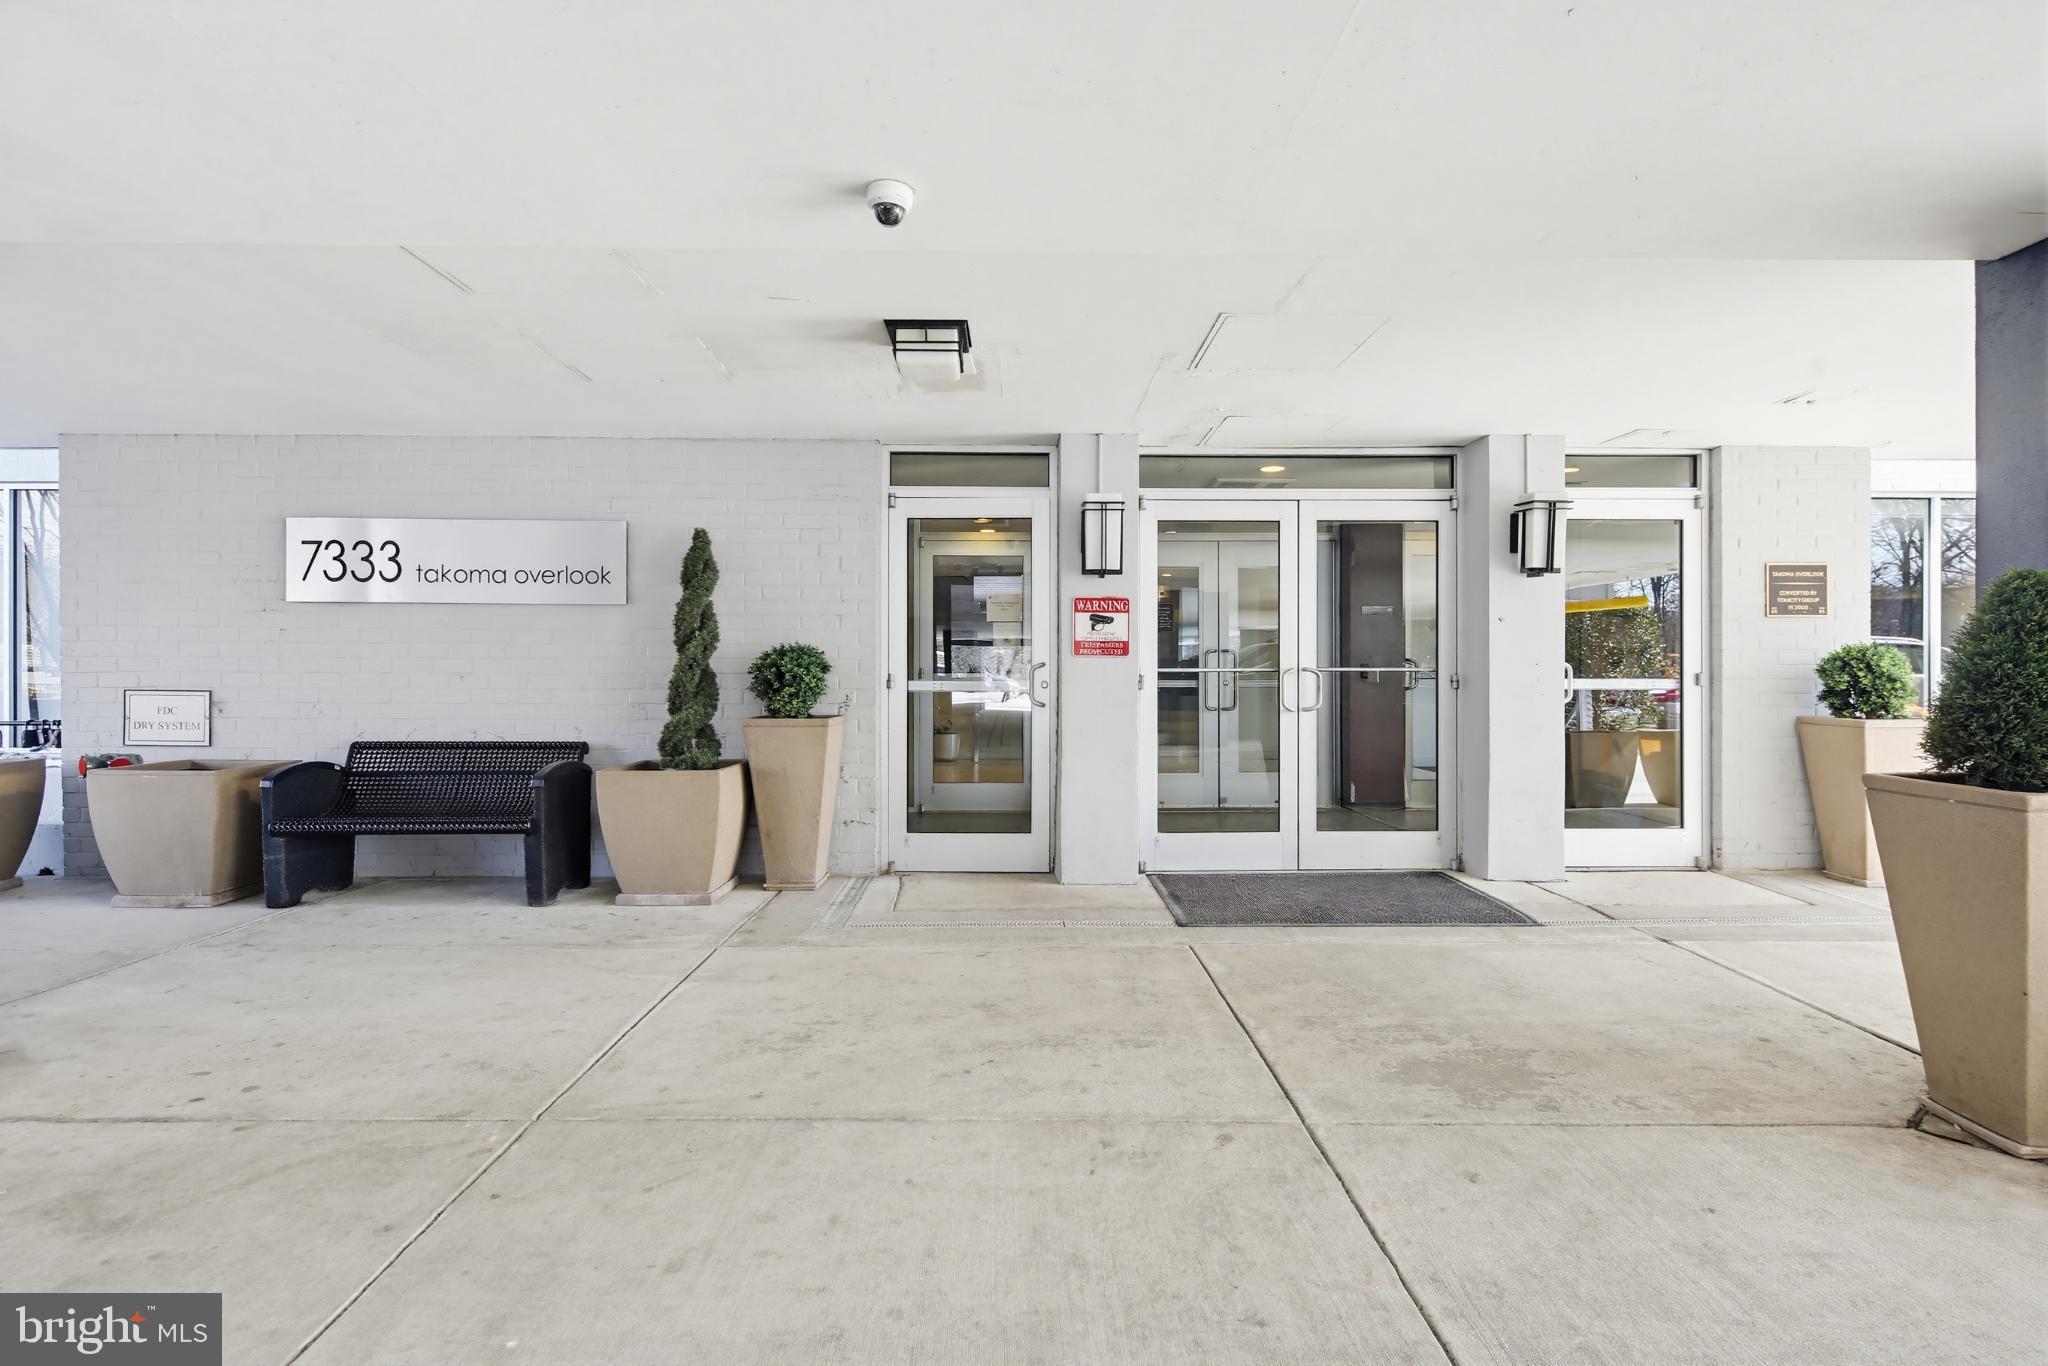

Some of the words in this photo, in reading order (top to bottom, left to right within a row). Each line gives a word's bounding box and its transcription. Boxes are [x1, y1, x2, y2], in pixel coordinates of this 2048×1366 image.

[301, 539, 403, 583] 7333
[416, 564, 507, 584] takoma
[514, 565, 612, 585] overlook
[1075, 600, 1129, 611] WARNING
[157, 706, 177, 715] FDC
[133, 721, 155, 730] DRY
[157, 721, 201, 731] SYSTEM
